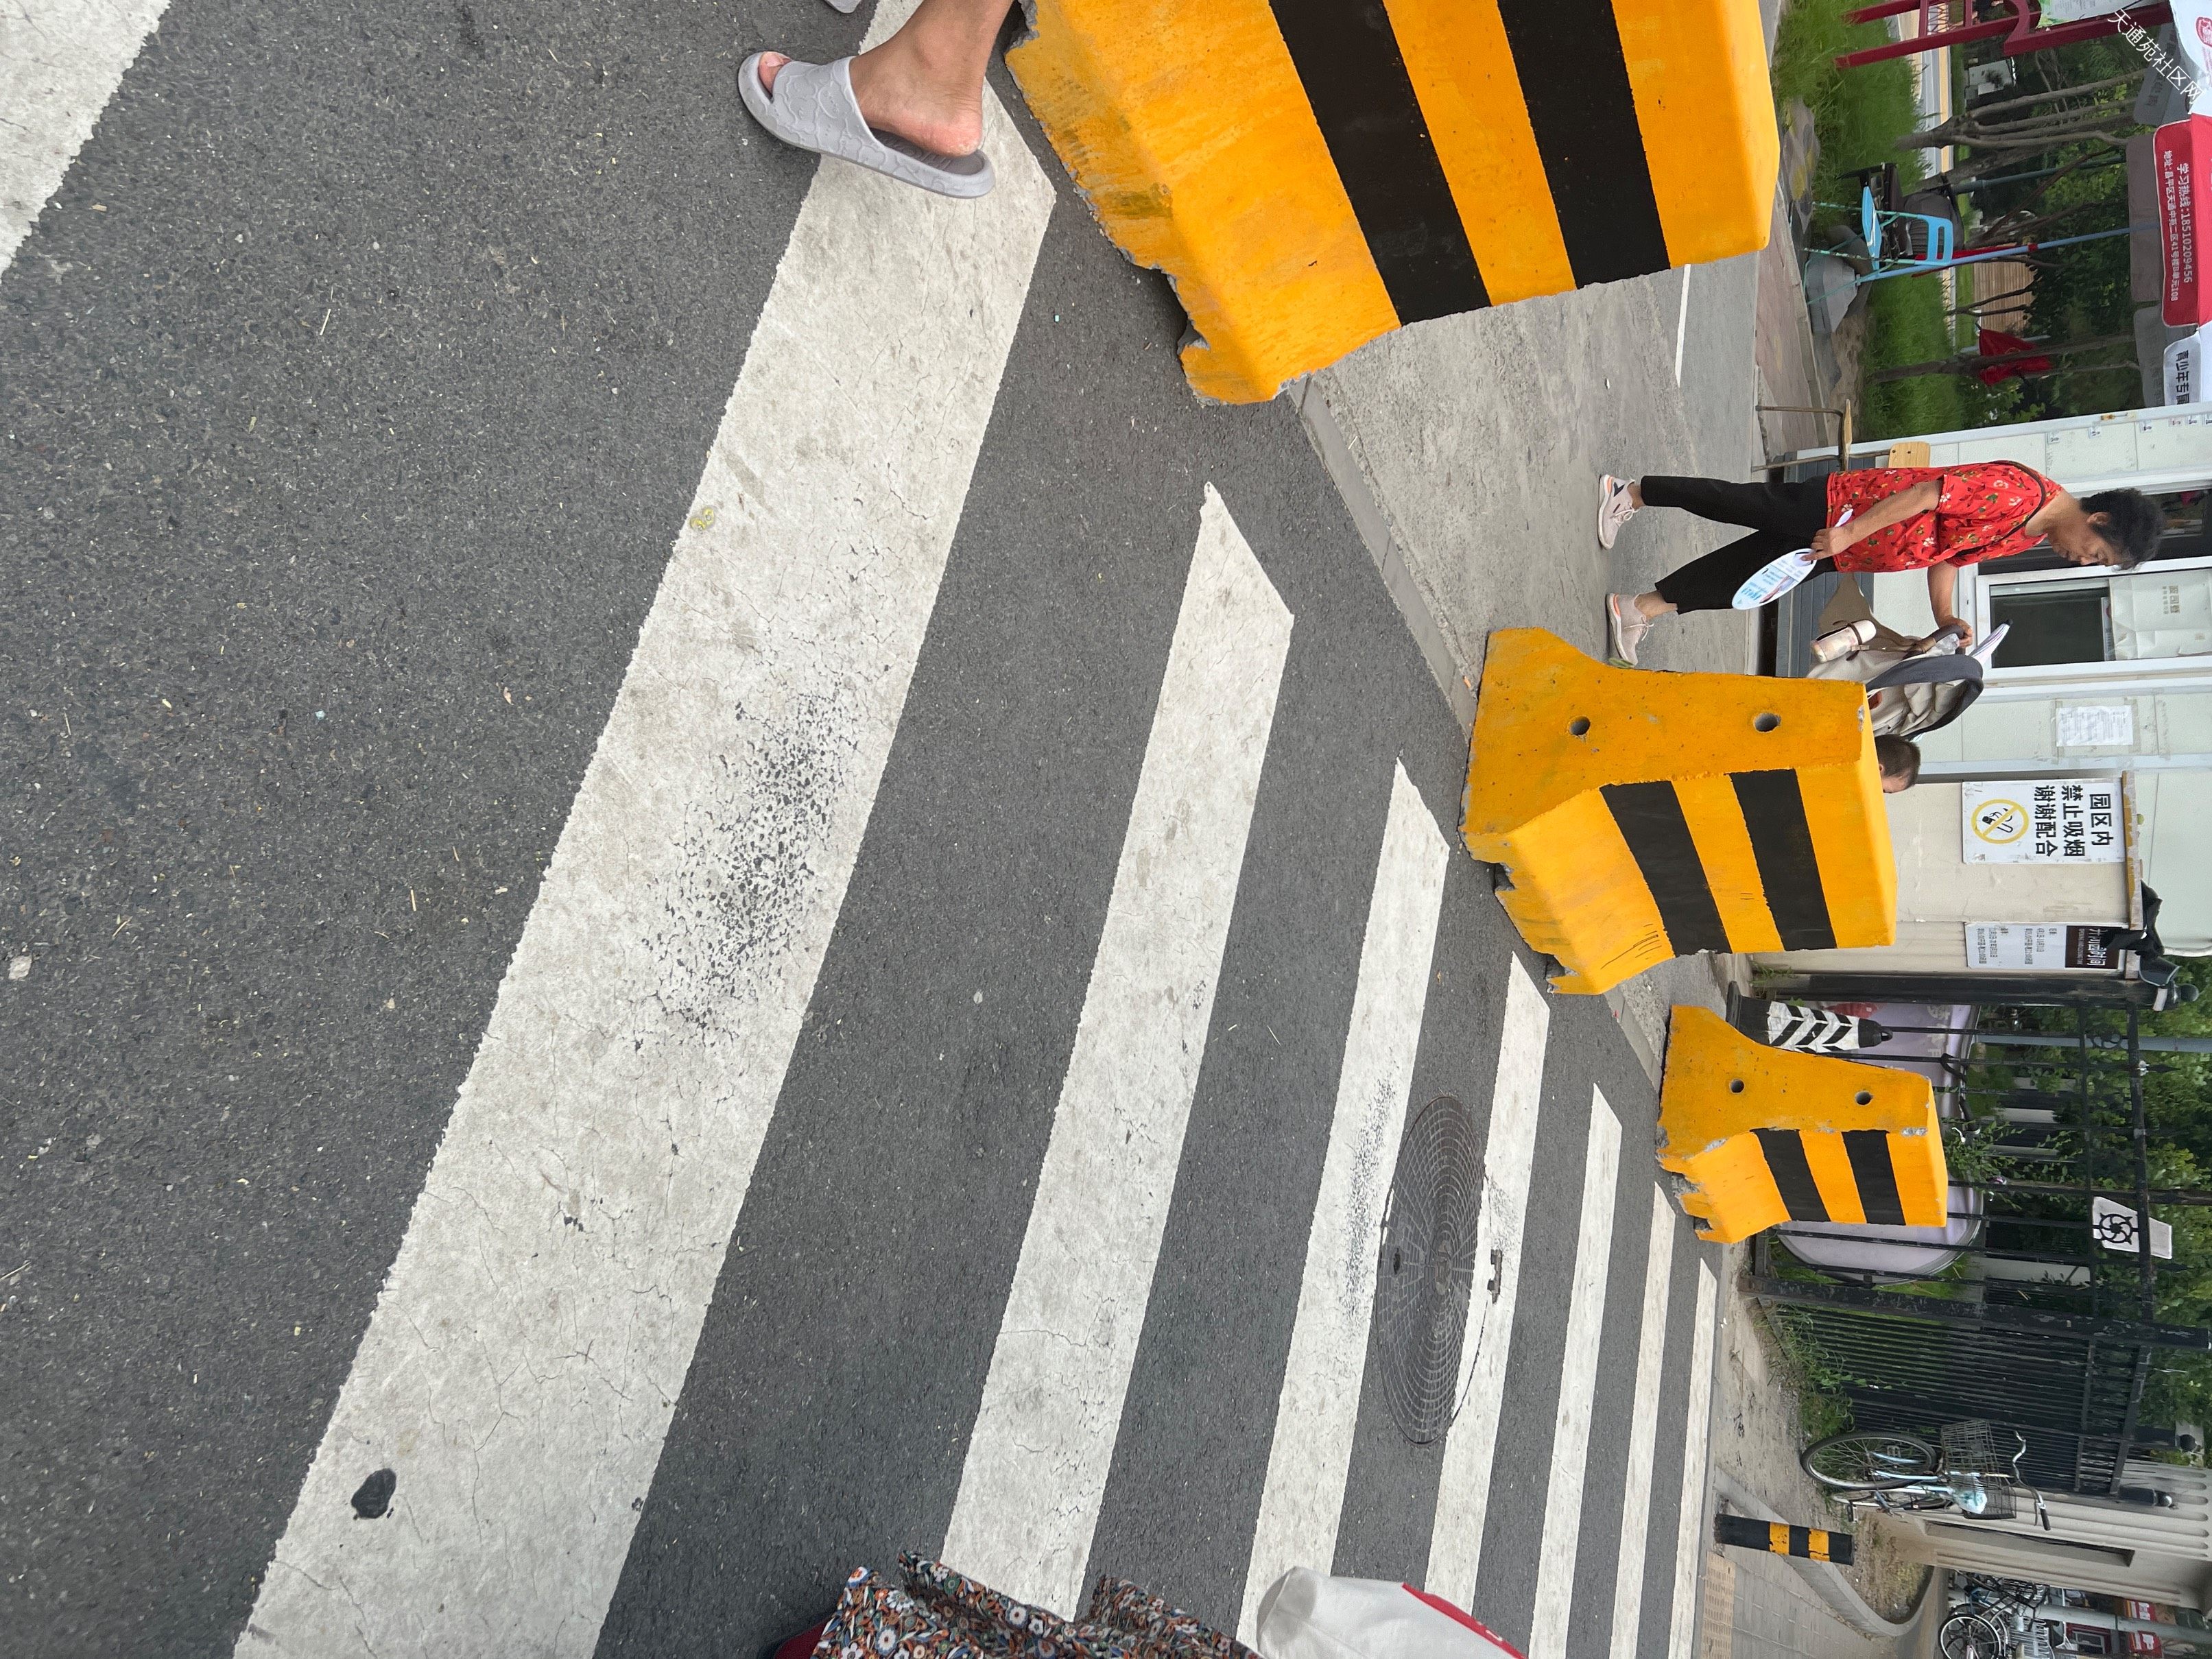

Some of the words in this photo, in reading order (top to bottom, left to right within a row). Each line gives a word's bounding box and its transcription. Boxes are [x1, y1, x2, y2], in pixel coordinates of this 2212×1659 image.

[2034, 785, 2058, 857] 谢谢配合
[2061, 785, 2086, 857] 禁止吸烟
[2089, 793, 2114, 846] 园区内
